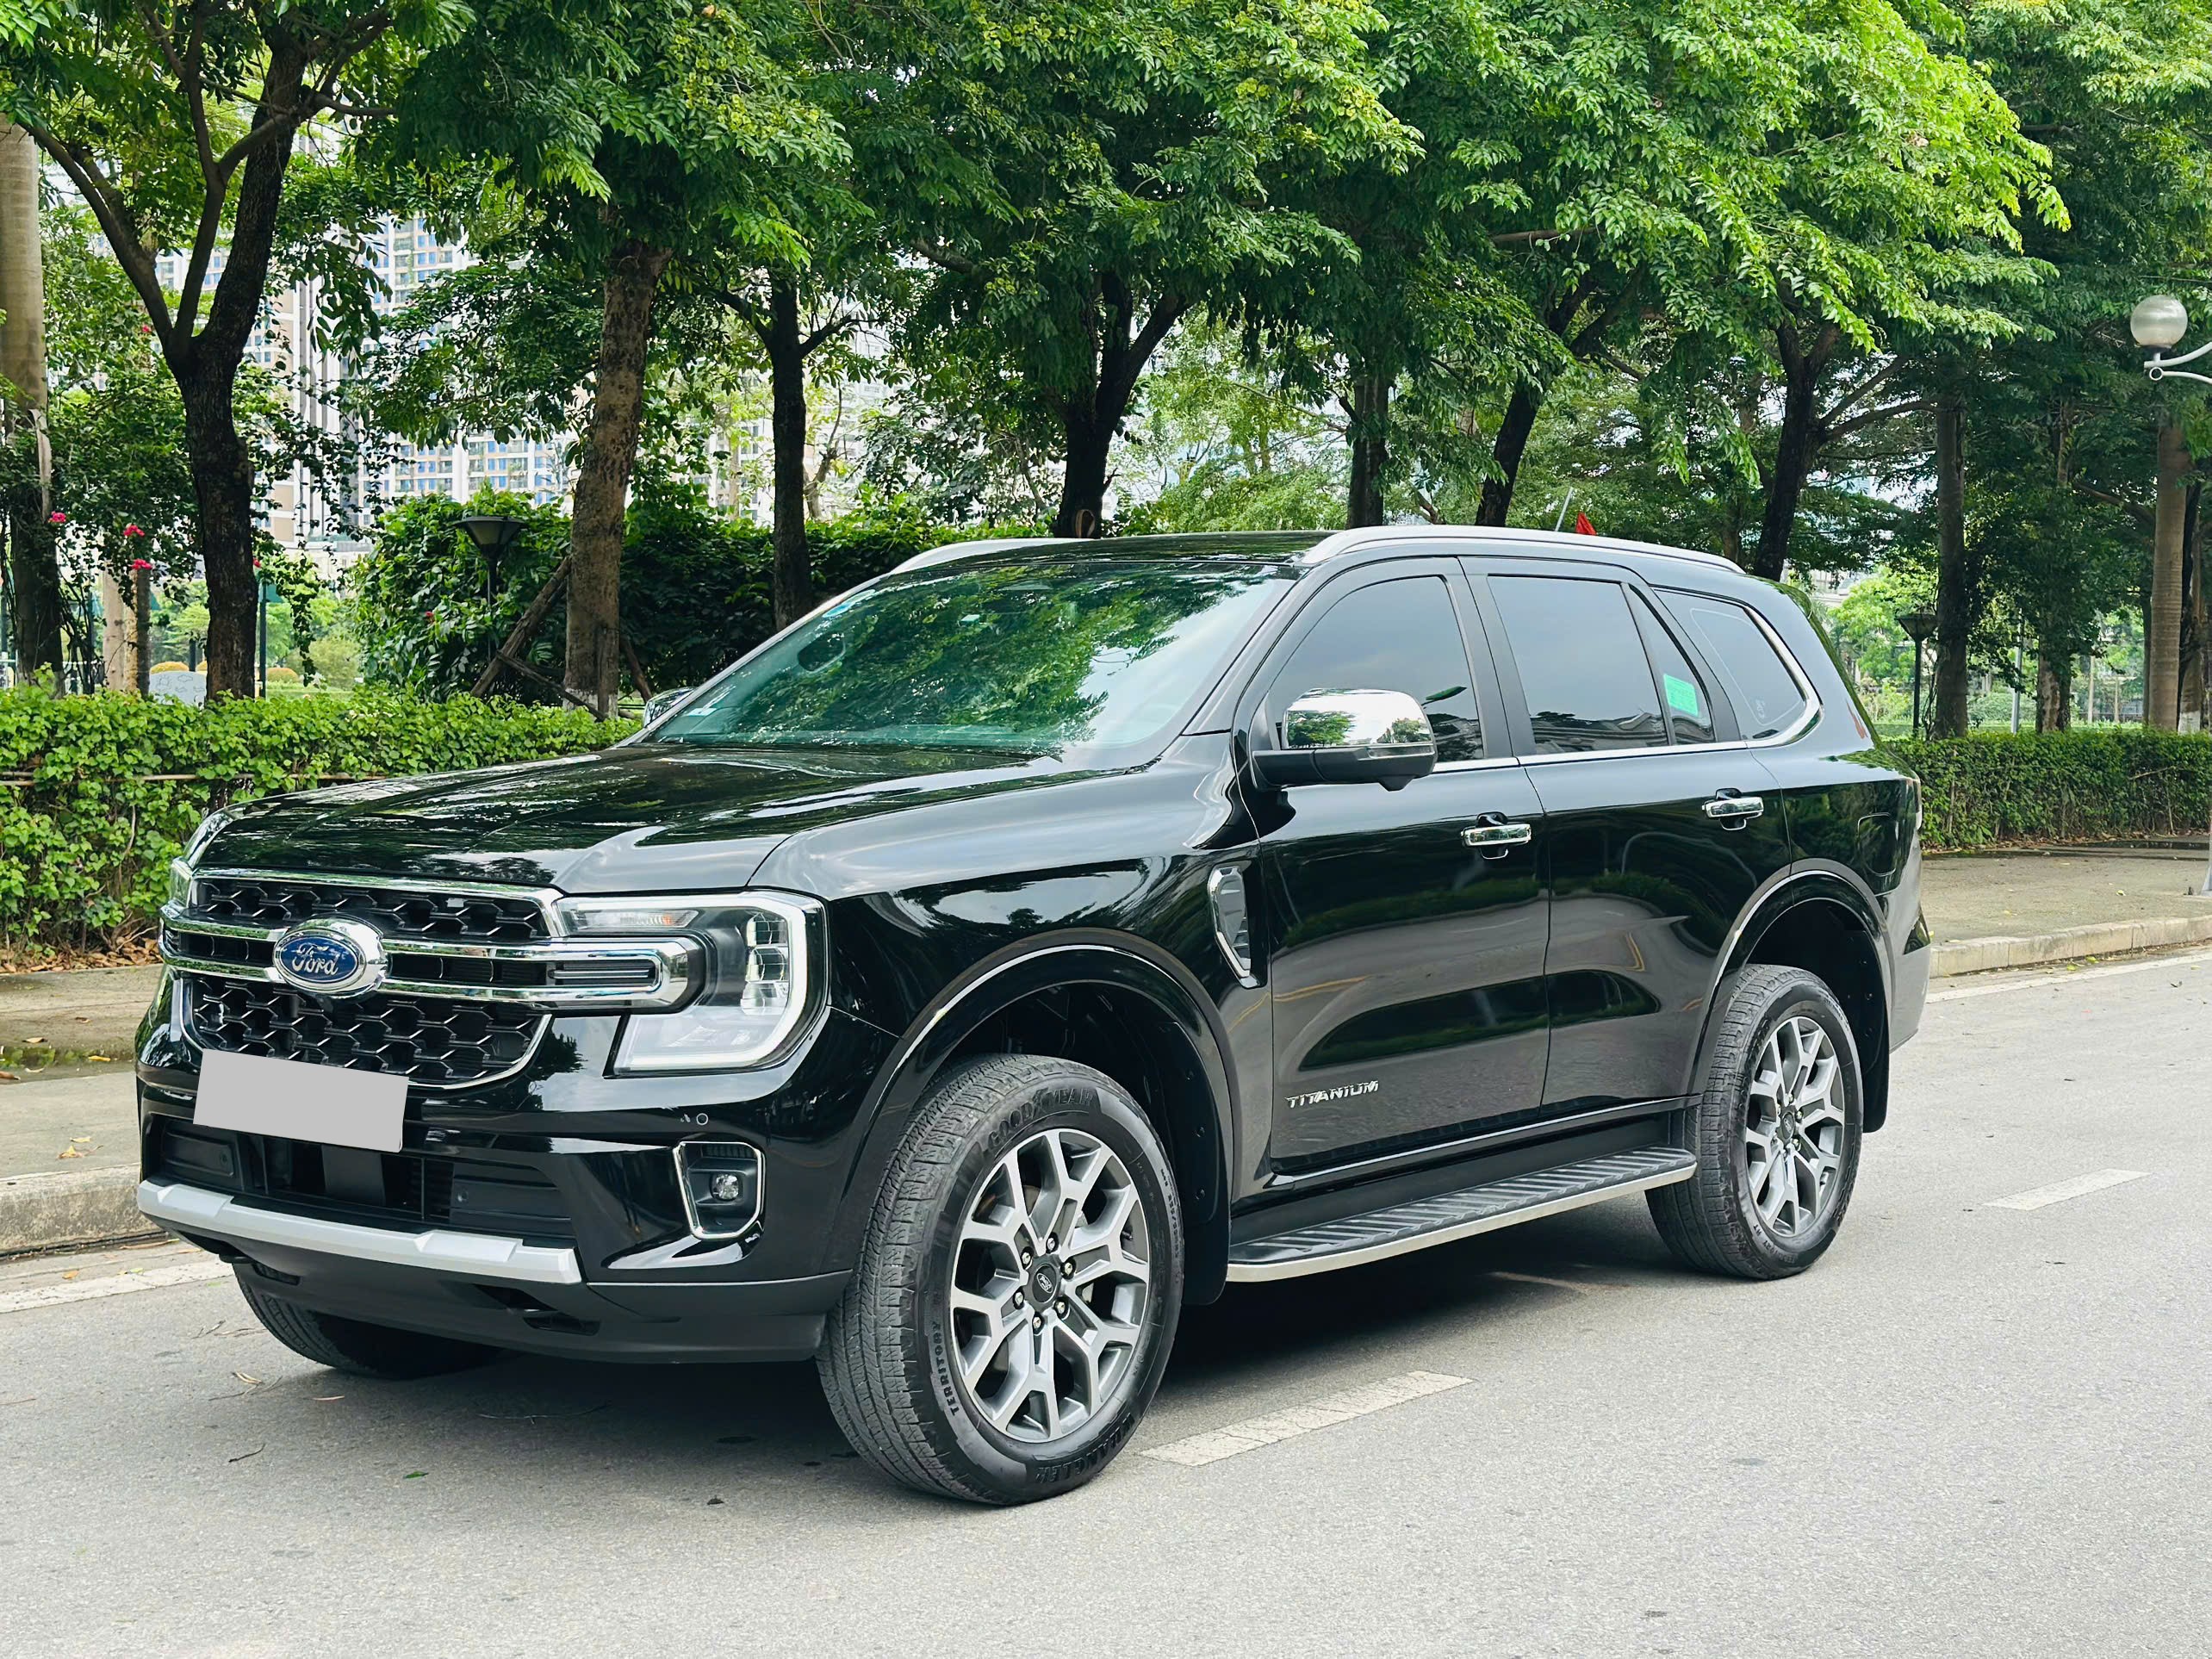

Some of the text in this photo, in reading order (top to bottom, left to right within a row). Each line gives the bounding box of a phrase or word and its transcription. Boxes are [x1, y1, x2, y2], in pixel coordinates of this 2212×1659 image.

[292, 942, 339, 976] Ford
[1284, 1080, 1379, 1109] TITANIUM
[931, 1320, 960, 1416] TERRITORY
